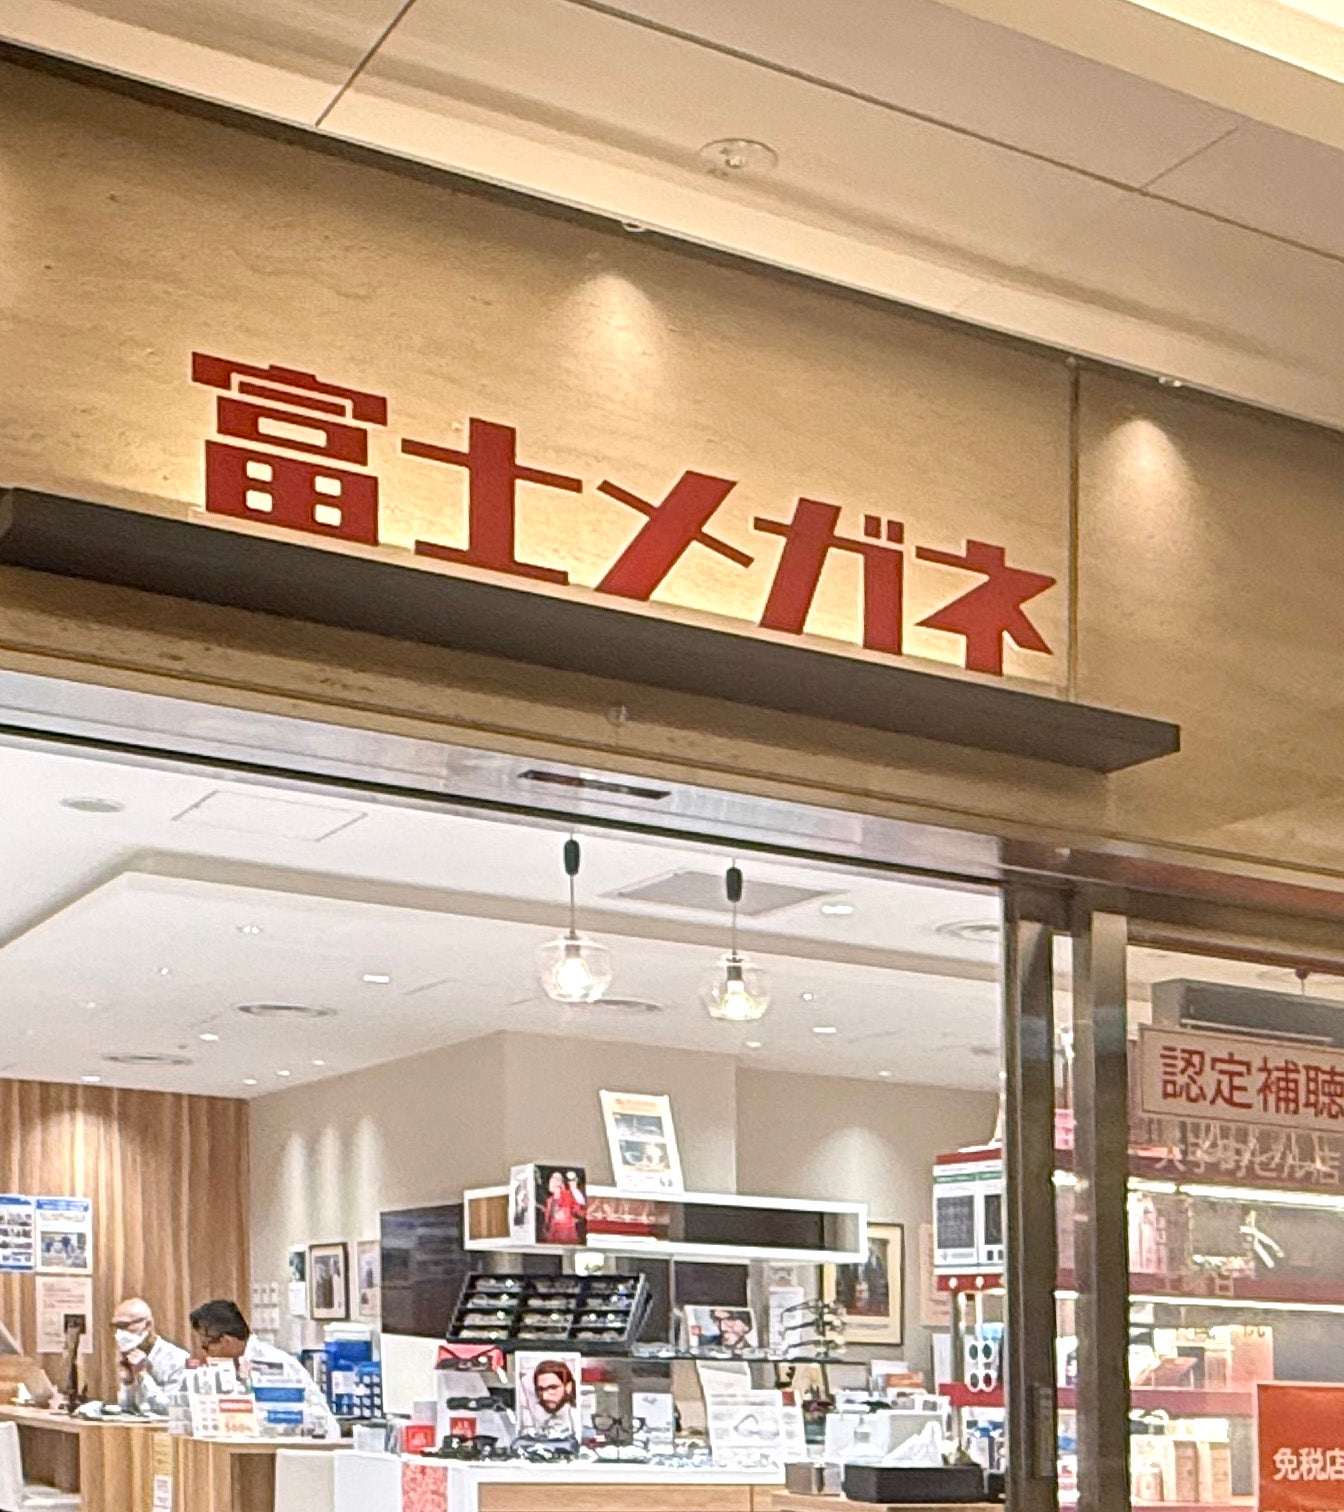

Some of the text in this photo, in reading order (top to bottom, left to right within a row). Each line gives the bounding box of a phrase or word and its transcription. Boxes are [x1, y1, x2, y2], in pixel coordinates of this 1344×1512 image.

[192, 351, 1057, 677] 富士メガネ
